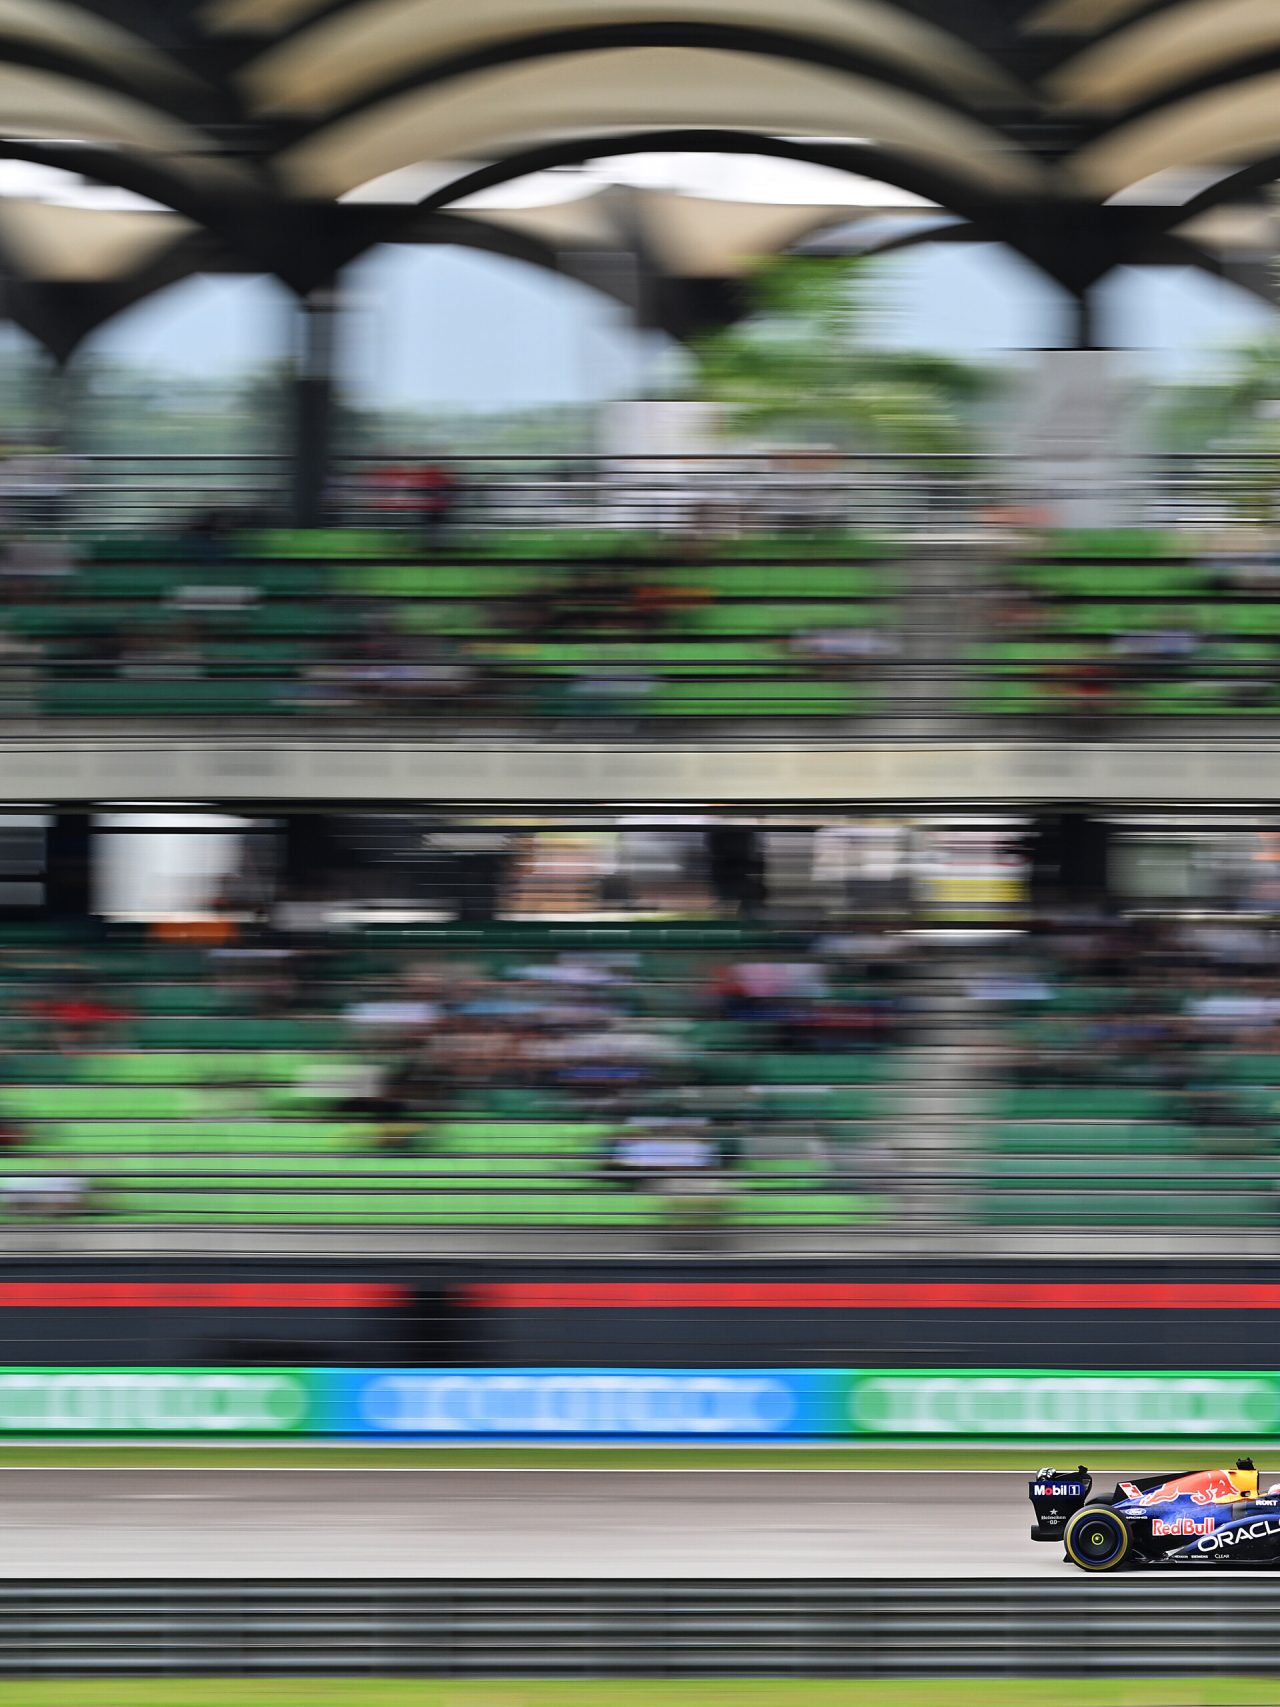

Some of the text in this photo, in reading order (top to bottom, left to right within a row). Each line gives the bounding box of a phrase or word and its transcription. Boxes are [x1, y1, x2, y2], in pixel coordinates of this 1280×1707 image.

[1034, 1485, 1067, 1496] Mobil
[1153, 1517, 1215, 1536] Red Bull
